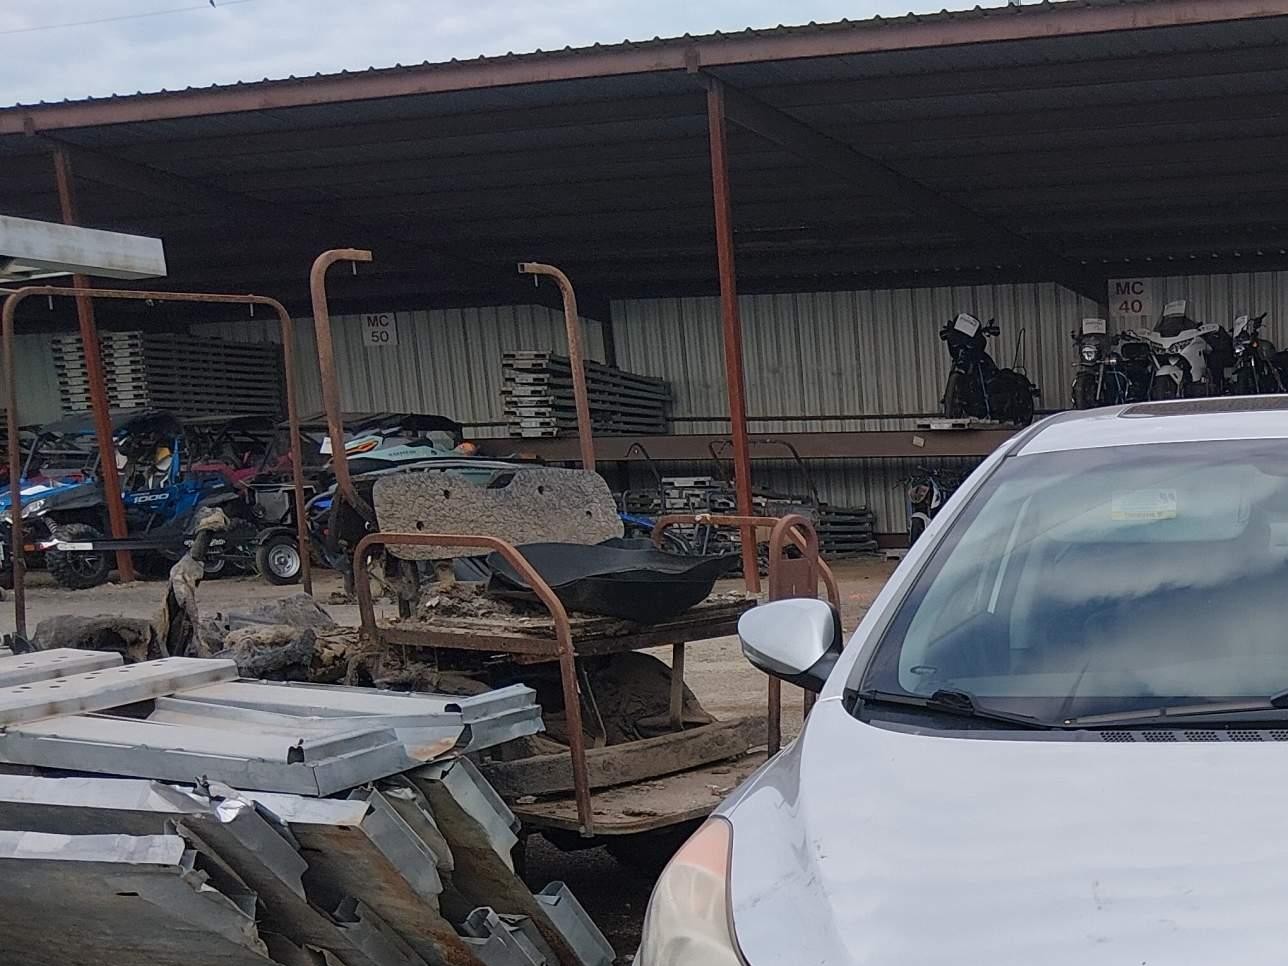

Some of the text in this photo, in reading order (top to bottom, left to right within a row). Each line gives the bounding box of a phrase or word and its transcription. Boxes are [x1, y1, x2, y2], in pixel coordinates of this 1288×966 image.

[1115, 281, 1144, 296] MC
[1119, 299, 1143, 314] 40
[366, 314, 390, 328] MC
[371, 330, 389, 343] 50
[133, 493, 170, 504] 1000
